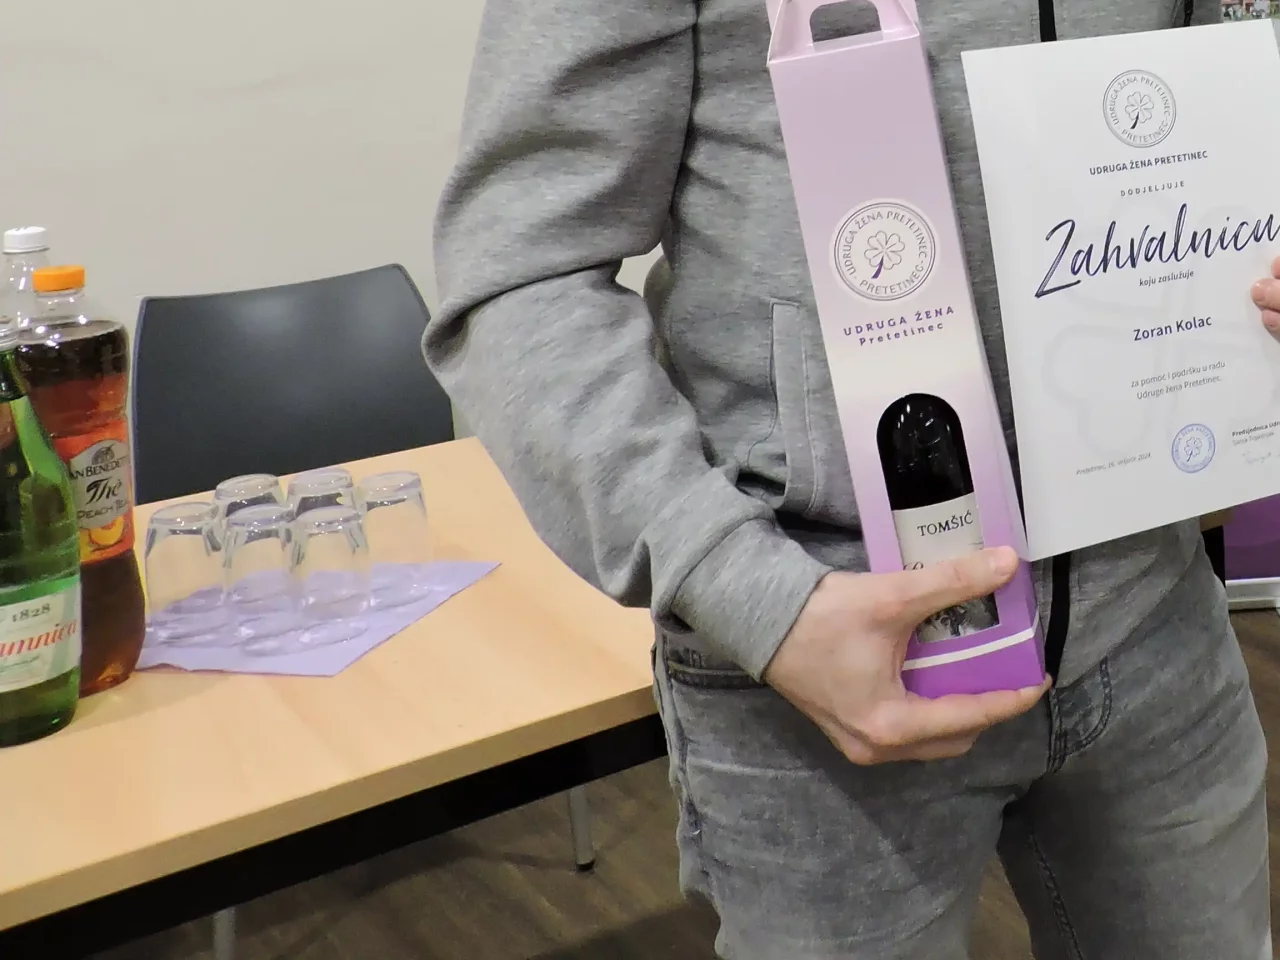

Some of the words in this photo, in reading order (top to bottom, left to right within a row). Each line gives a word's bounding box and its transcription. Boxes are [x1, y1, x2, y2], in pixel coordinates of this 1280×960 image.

[1121, 120, 1169, 143] PRETETINEC
[1089, 163, 1128, 175] UDRUGA
[1129, 157, 1153, 170] ŽENA
[1154, 150, 1208, 166] PRETETINEC
[1120, 180, 1185, 197] DODJELJUJE
[843, 230, 858, 276] UDRUGA
[855, 211, 883, 230] ŽENA
[886, 210, 928, 259] PRETETINEC
[859, 263, 924, 295] PRETETINEC
[1139, 274, 1157, 287] koju
[1158, 268, 1194, 284] zaslužuje
[843, 316, 907, 336] UDRUGA
[914, 306, 954, 322] ŽENA
[1133, 324, 1173, 341] Zoran
[1175, 315, 1213, 334] Kolac
[859, 322, 944, 346] Pretetinec
[1130, 380, 1139, 388] za
[1136, 387, 1165, 400] Udruge
[917, 510, 974, 536] TOMŠIĆ
[12, 603, 51, 623] 1828
